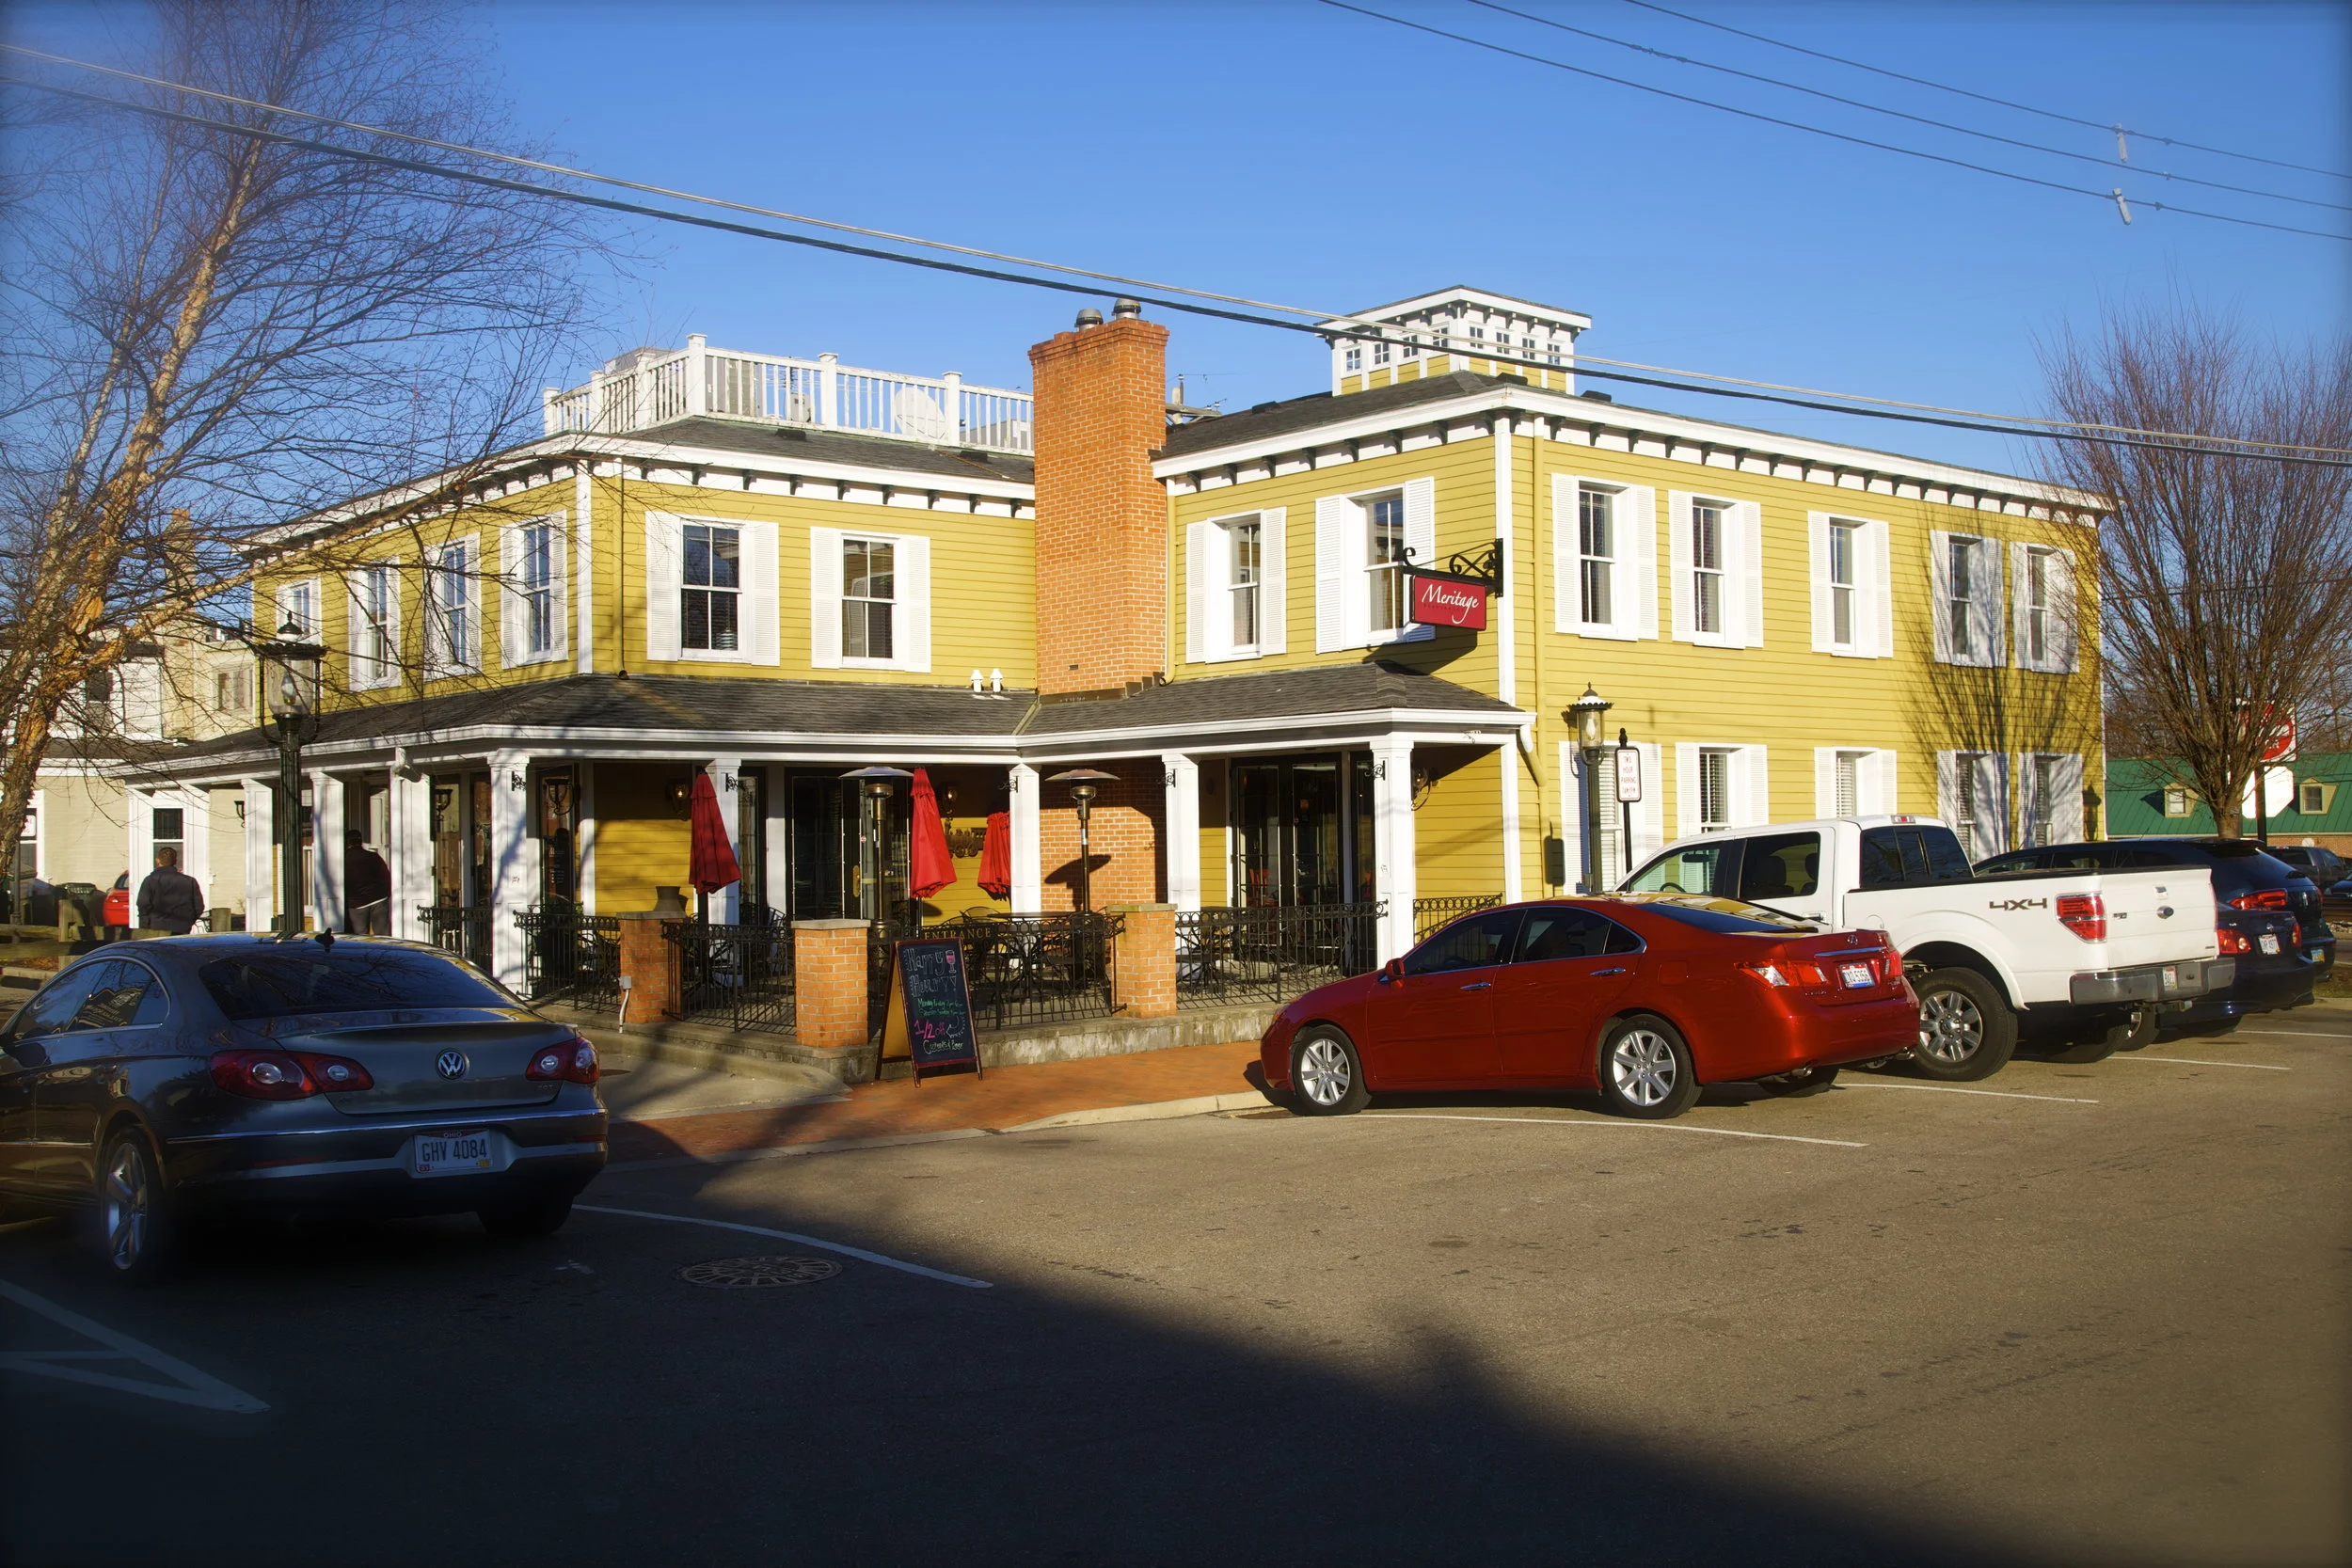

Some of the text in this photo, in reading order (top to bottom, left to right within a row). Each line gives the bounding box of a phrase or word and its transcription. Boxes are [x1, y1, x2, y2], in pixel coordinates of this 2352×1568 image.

[1422, 583, 1479, 625] Meritage
[1620, 776, 1637, 784] PARKING
[924, 927, 992, 940] ENTRANCE
[904, 947, 946, 976] Happy
[914, 1019, 946, 1039] 1/2 off
[421, 1138, 487, 1163] GHV 4084
